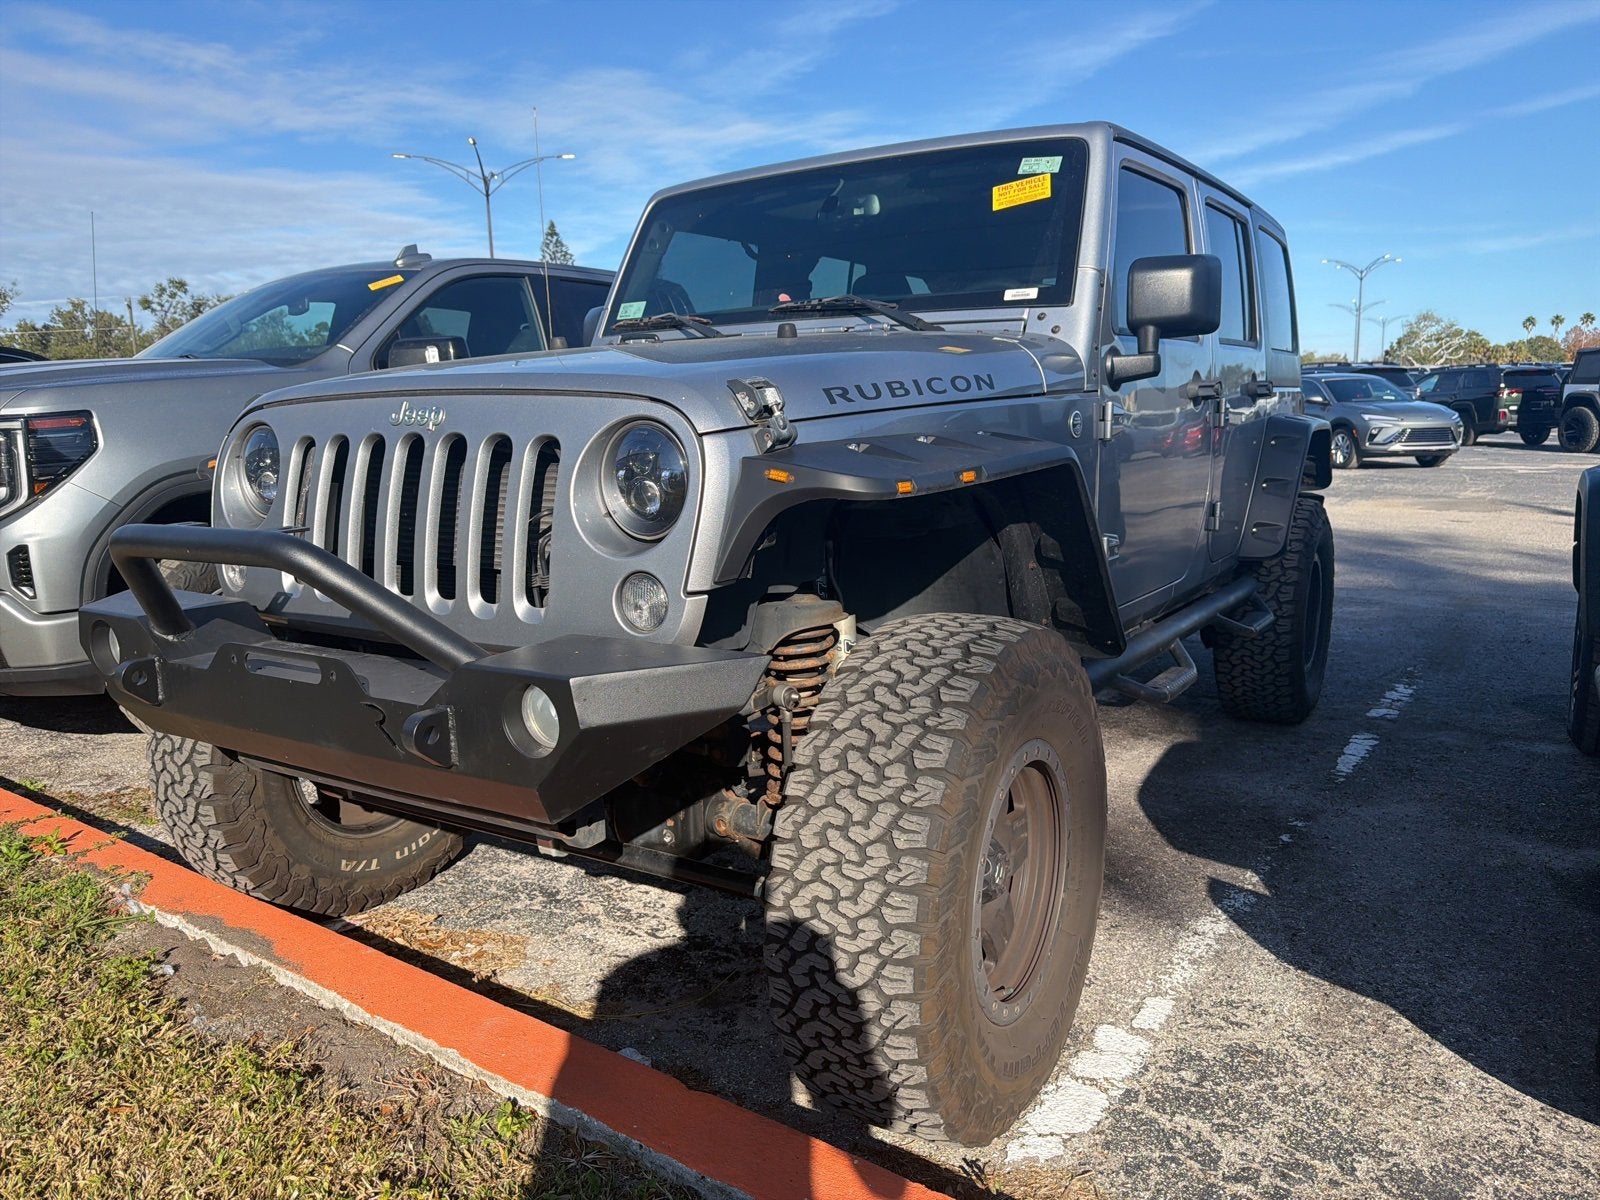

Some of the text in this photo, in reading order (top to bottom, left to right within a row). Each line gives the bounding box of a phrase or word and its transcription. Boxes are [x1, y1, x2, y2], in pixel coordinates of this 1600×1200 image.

[997, 175, 1048, 193] THIS VEHICLE
[998, 190, 1012, 198] NOT
[1013, 186, 1027, 194] FOR
[1028, 181, 1046, 190] SALE
[822, 373, 996, 405] RUBICON
[389, 400, 446, 432] Jeep
[340, 858, 380, 873] T/A
